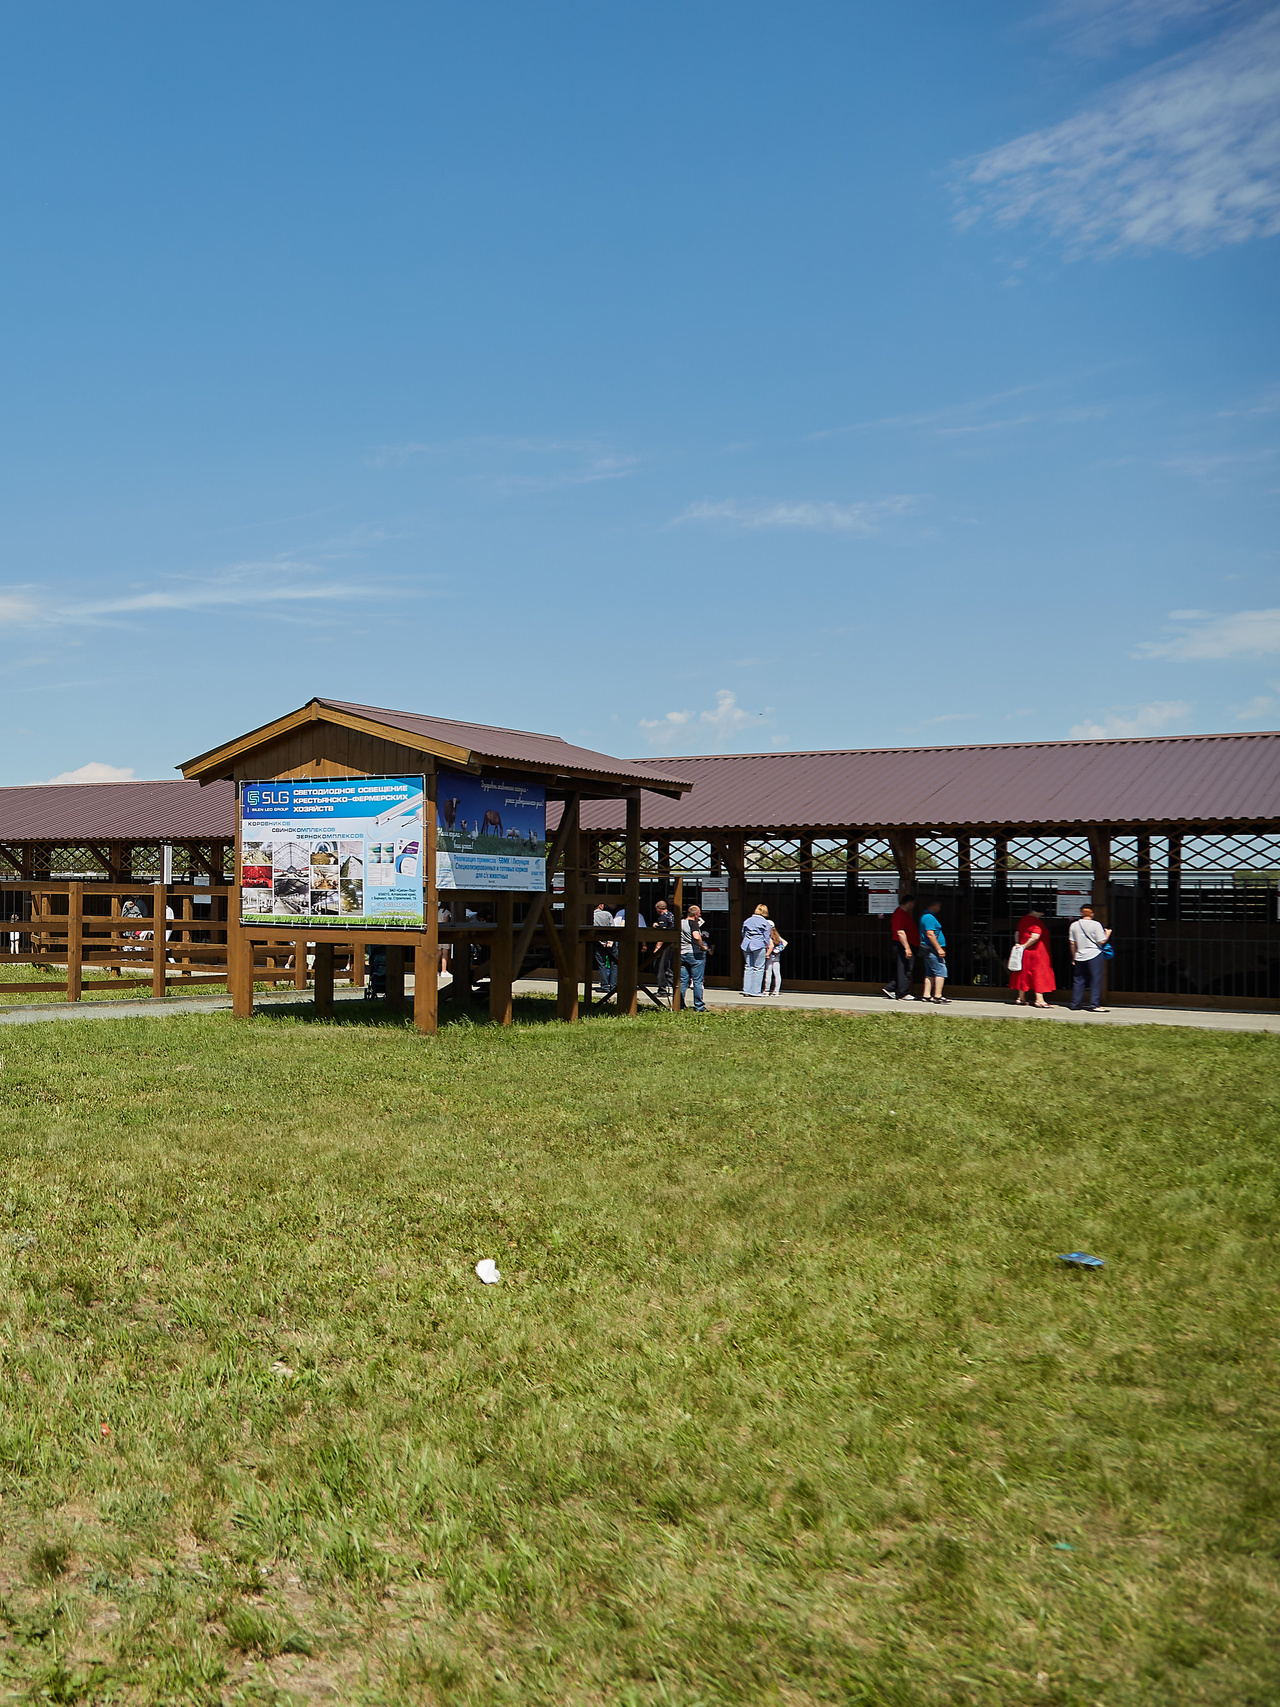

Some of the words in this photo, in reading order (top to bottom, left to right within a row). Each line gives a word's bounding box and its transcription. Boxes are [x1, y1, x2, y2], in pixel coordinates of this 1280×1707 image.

[293, 787, 355, 796] СВЕТОДИОДНОЕ
[358, 785, 408, 794] ОСВЕЩЕНИЕ
[262, 791, 289, 804] SLG
[293, 794, 408, 804] КРЕСТЬЯНСКО-ФЕРМЕРСКИХ
[293, 805, 334, 813] ХОЗЯЙСТВ
